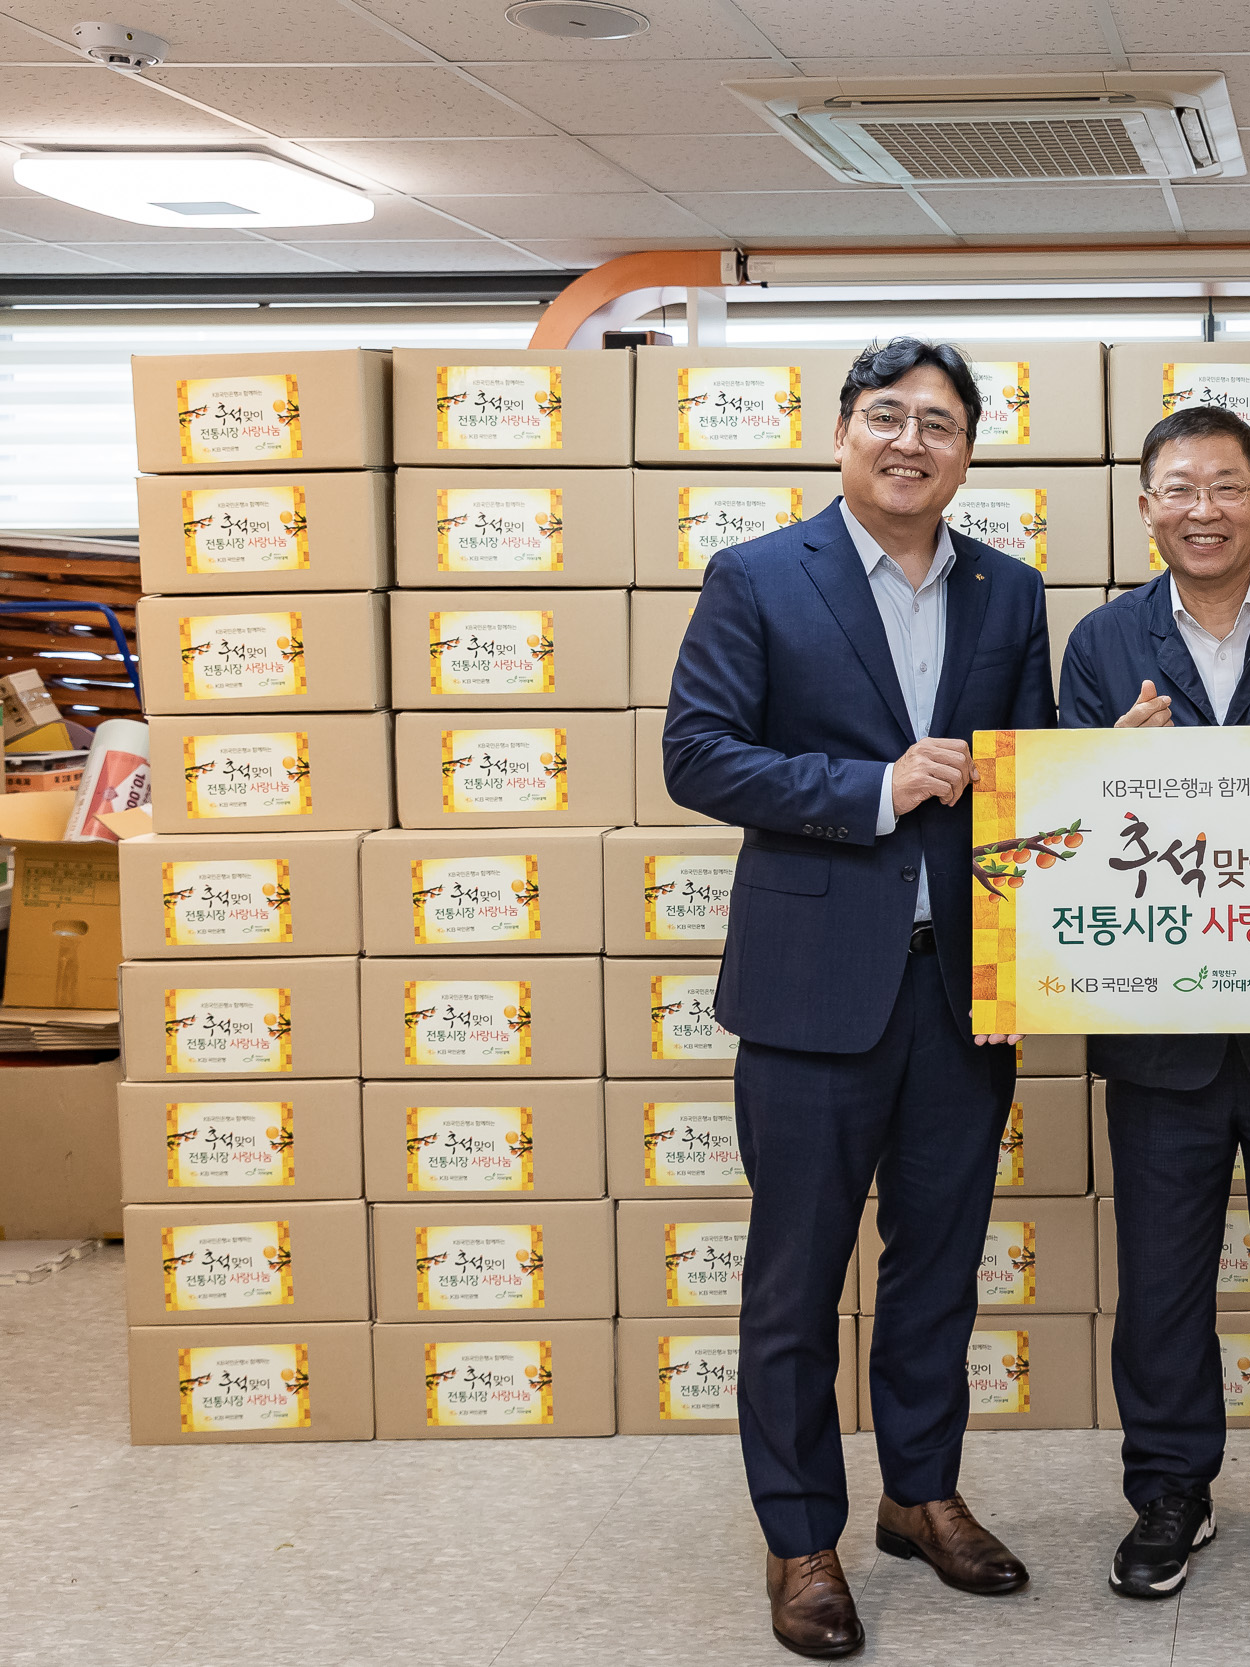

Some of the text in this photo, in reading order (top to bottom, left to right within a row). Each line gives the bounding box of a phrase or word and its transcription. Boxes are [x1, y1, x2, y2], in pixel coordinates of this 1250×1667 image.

[474, 390, 523, 413] 추석맞이
[715, 391, 763, 414] 추석맞이
[215, 402, 263, 426] 추석맞이
[458, 415, 541, 426] 전통시장 사랑나눔
[699, 415, 780, 427] 전통시장 사랑나눔
[201, 425, 280, 440] 전통시장 사랑나눔
[221, 513, 269, 536] 추석맞이
[475, 512, 524, 535] 추석맞이
[715, 510, 764, 534] 추석맞이
[959, 512, 1008, 535] 추석맞이
[206, 536, 287, 550] 전통시장 사랑나눔
[459, 537, 541, 548] 전통시장 사랑나눔
[986, 537, 1026, 548] 사랑나눔
[218, 639, 266, 662] 추석맞이
[467, 635, 516, 658] 추석맞이
[204, 662, 284, 676] 전통시장 사랑나눔
[451, 660, 533, 671] 전통시장 사랑나눔
[223, 758, 272, 782] 추석맞이
[480, 753, 529, 776] 추석맞이
[208, 782, 290, 795] 전통시장 사랑나눔
[464, 777, 546, 790] 전통시장 사랑나눔
[1103, 778, 1213, 799] KB국민은행과
[201, 884, 251, 908] 추석맞이
[451, 882, 500, 906] 추석맞이
[186, 909, 269, 922] 전통시장 사랑나눔
[435, 905, 518, 920] 전통시장 사랑나눔
[666, 905, 706, 917] 전통시장
[1052, 905, 1192, 946] 전통시장
[443, 1005, 492, 1029] 추석맞이
[203, 1013, 252, 1037] 추석맞이
[673, 1025, 713, 1036] 전통시장
[427, 1030, 510, 1042] 전통시장 사랑나눔
[187, 1038, 270, 1050] 전통시장 사랑나눔
[205, 1126, 255, 1150] 추석맞이
[445, 1131, 494, 1155] 추석맞이
[682, 1126, 732, 1150] 추석맞이
[189, 1152, 272, 1164] 전통시장 사랑나눔
[429, 1156, 511, 1168] 전통시장 사랑나눔
[666, 1152, 706, 1163] 전통시장
[202, 1249, 252, 1273] 추석맞이
[455, 1250, 504, 1273] 추석맞이
[186, 1272, 270, 1287] 전통시장 사랑나눔
[439, 1274, 522, 1287] 전통시장 사랑나눔
[688, 1271, 727, 1284] 전통시장
[219, 1370, 269, 1394] 추석맞이
[464, 1366, 513, 1389] 추석맞이
[448, 1390, 531, 1403] 전통시장 사랑나눔
[681, 1384, 720, 1397] 전통시장
[203, 1394, 288, 1408] 전통시장 사랑나눔
